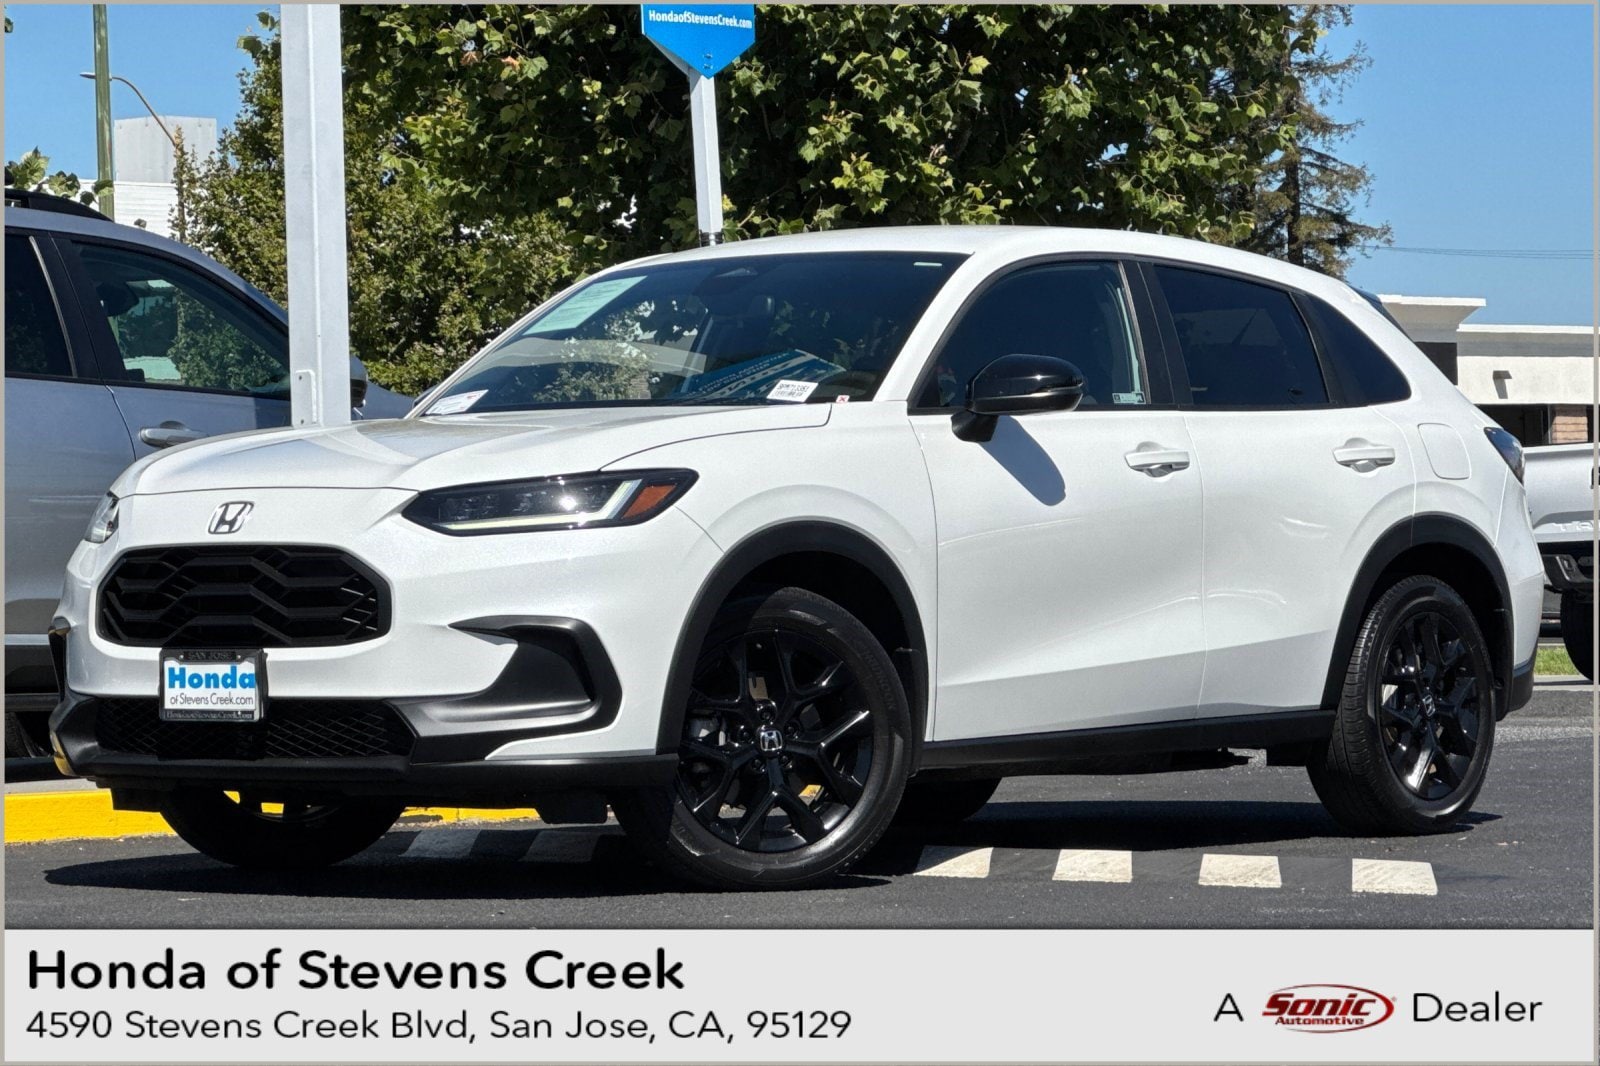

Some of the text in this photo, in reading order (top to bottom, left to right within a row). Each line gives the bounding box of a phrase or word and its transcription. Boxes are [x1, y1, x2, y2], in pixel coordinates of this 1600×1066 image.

[648, 9, 752, 28] HondaofStevensCreek.com
[168, 665, 256, 688] Honda
[170, 691, 254, 705] of Stevens Creek.com
